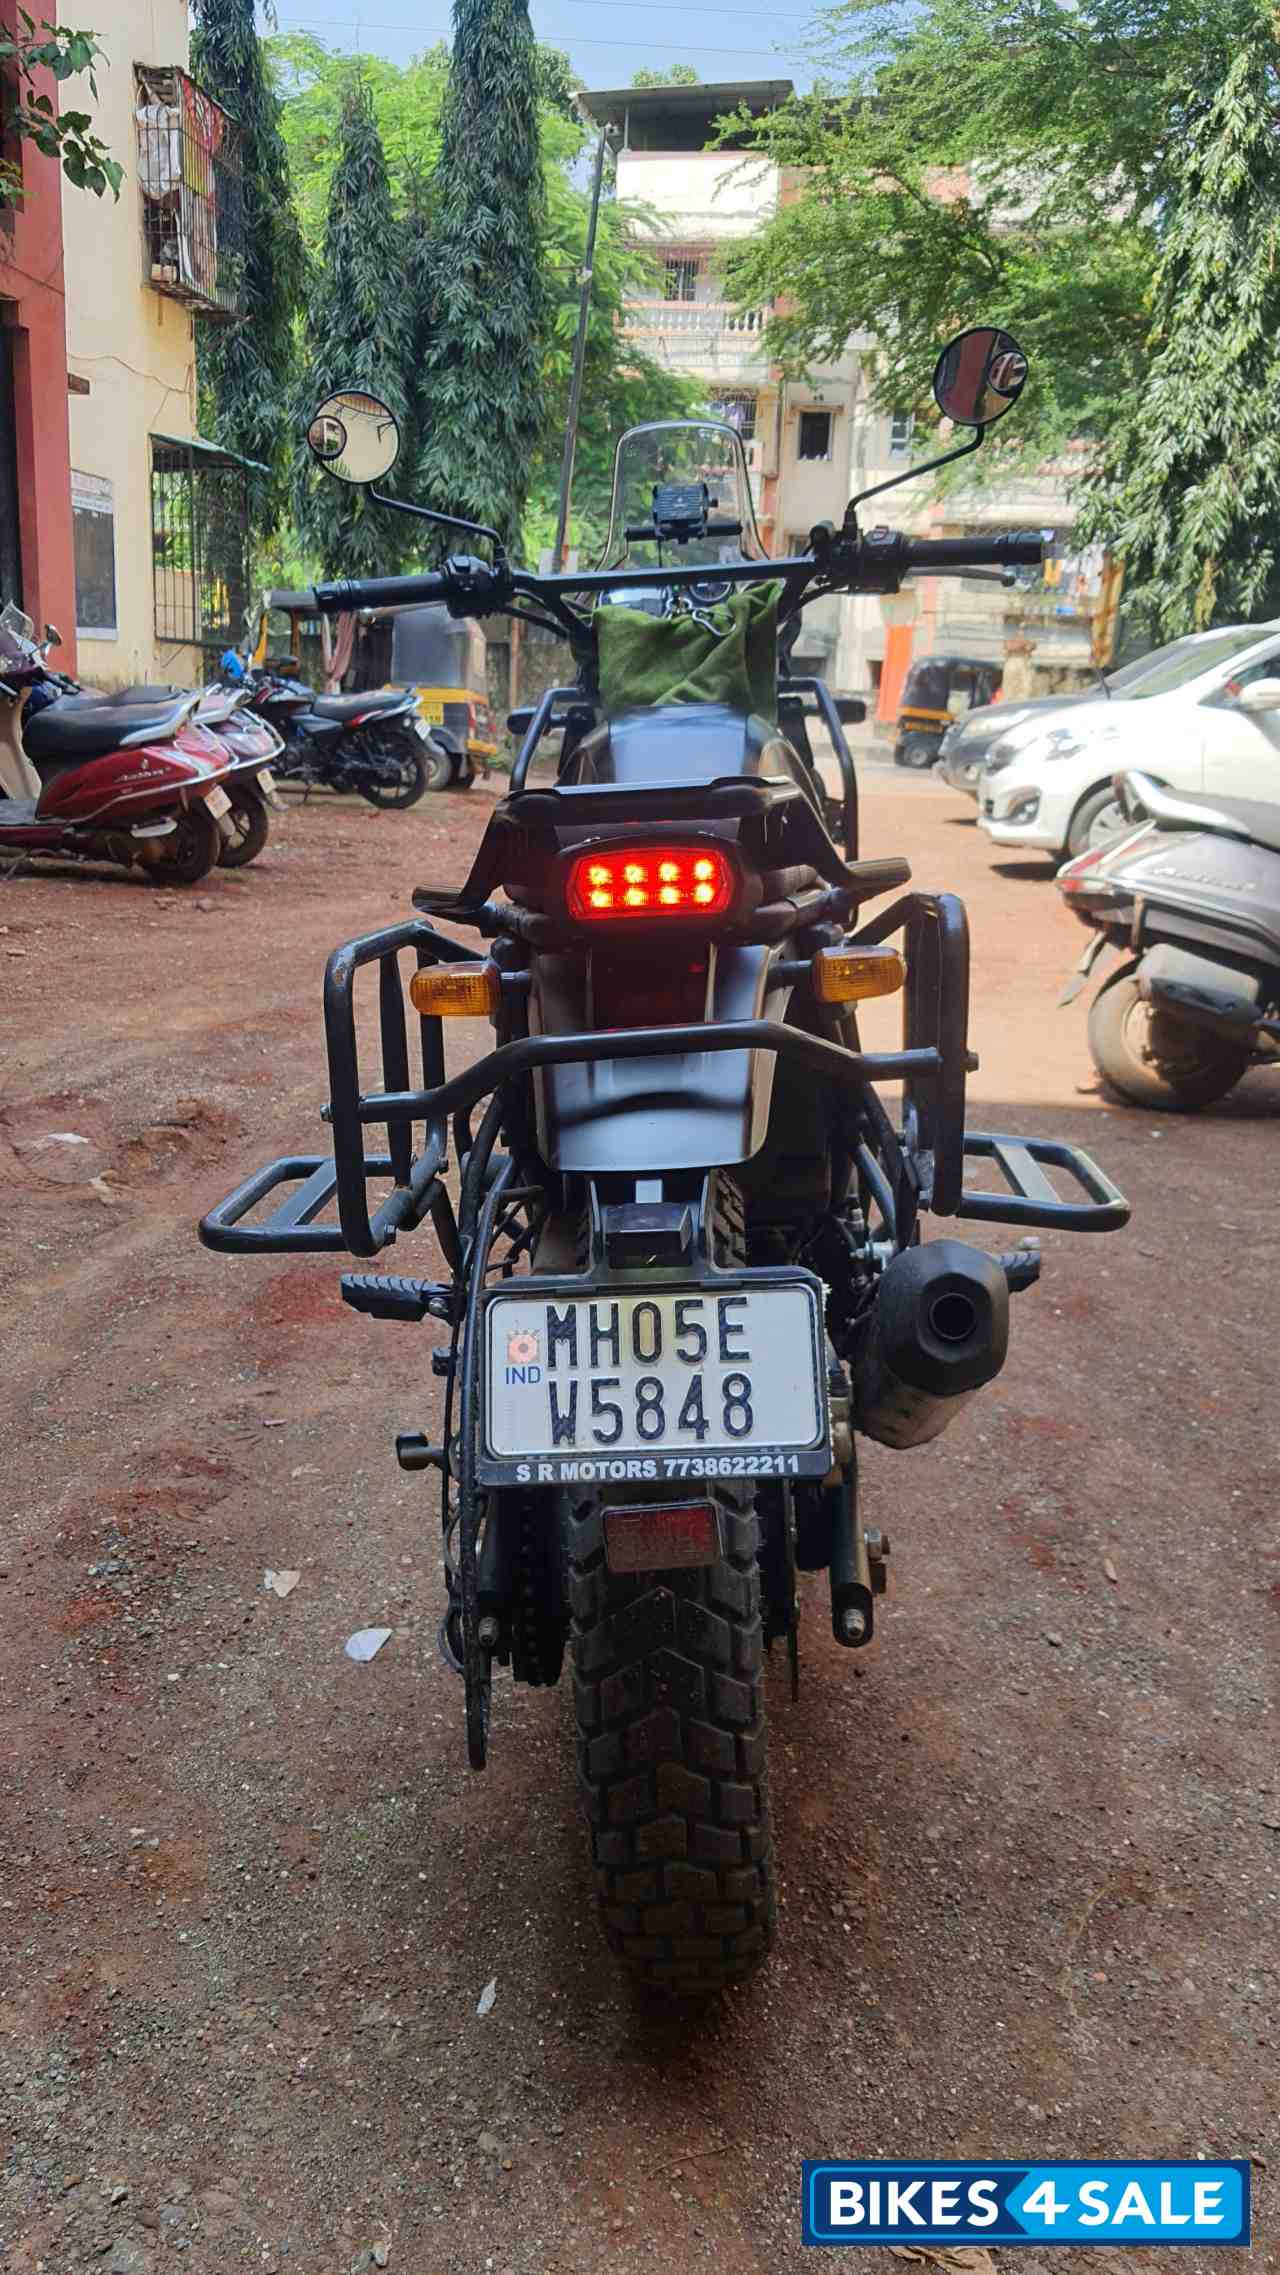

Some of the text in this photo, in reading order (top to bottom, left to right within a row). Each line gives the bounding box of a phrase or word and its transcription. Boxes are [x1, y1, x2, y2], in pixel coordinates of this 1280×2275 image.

[546, 1297, 751, 1368] MH05E
[505, 1366, 541, 1385] IND
[548, 1373, 753, 1445] W5848
[516, 1455, 799, 1481] S R MOTORS 7738622211
